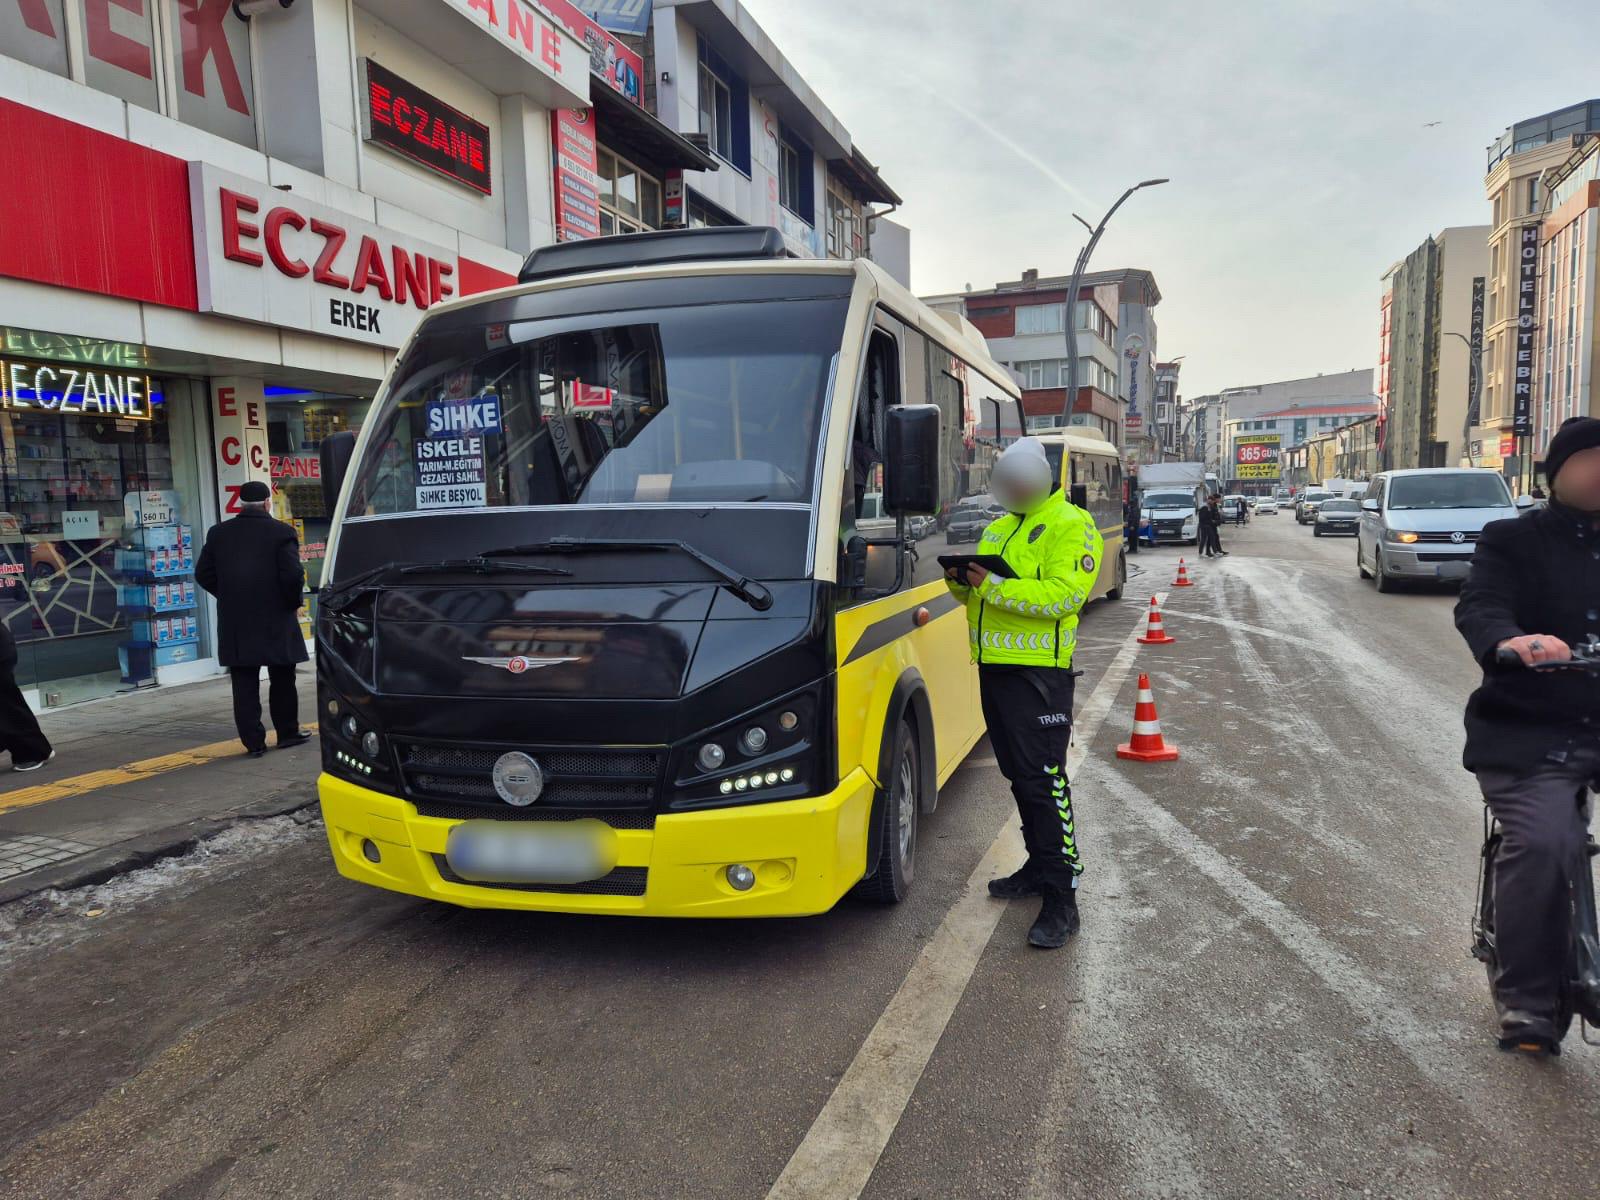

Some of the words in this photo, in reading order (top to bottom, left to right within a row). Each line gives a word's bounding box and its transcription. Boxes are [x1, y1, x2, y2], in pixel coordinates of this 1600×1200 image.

[17, 0, 250, 116] EK
[371, 81, 485, 172] ECZANE
[219, 186, 453, 310] ECZANE
[1519, 229, 1537, 309] HOTEL
[329, 298, 381, 333] EREK
[10, 363, 144, 416] ECZANE
[430, 403, 497, 431] SIHKE
[1240, 446, 1260, 461] 365
[1261, 447, 1278, 458] GÜN
[420, 472, 455, 485] CEZAEVİ
[456, 470, 481, 483] SAHİL
[1237, 464, 1276, 472] UYGUN
[420, 489, 447, 504] SIHKE
[448, 487, 483, 505] BEŞYOL
[159, 512, 168, 520] TL
[1037, 713, 1069, 725] TRAFK
